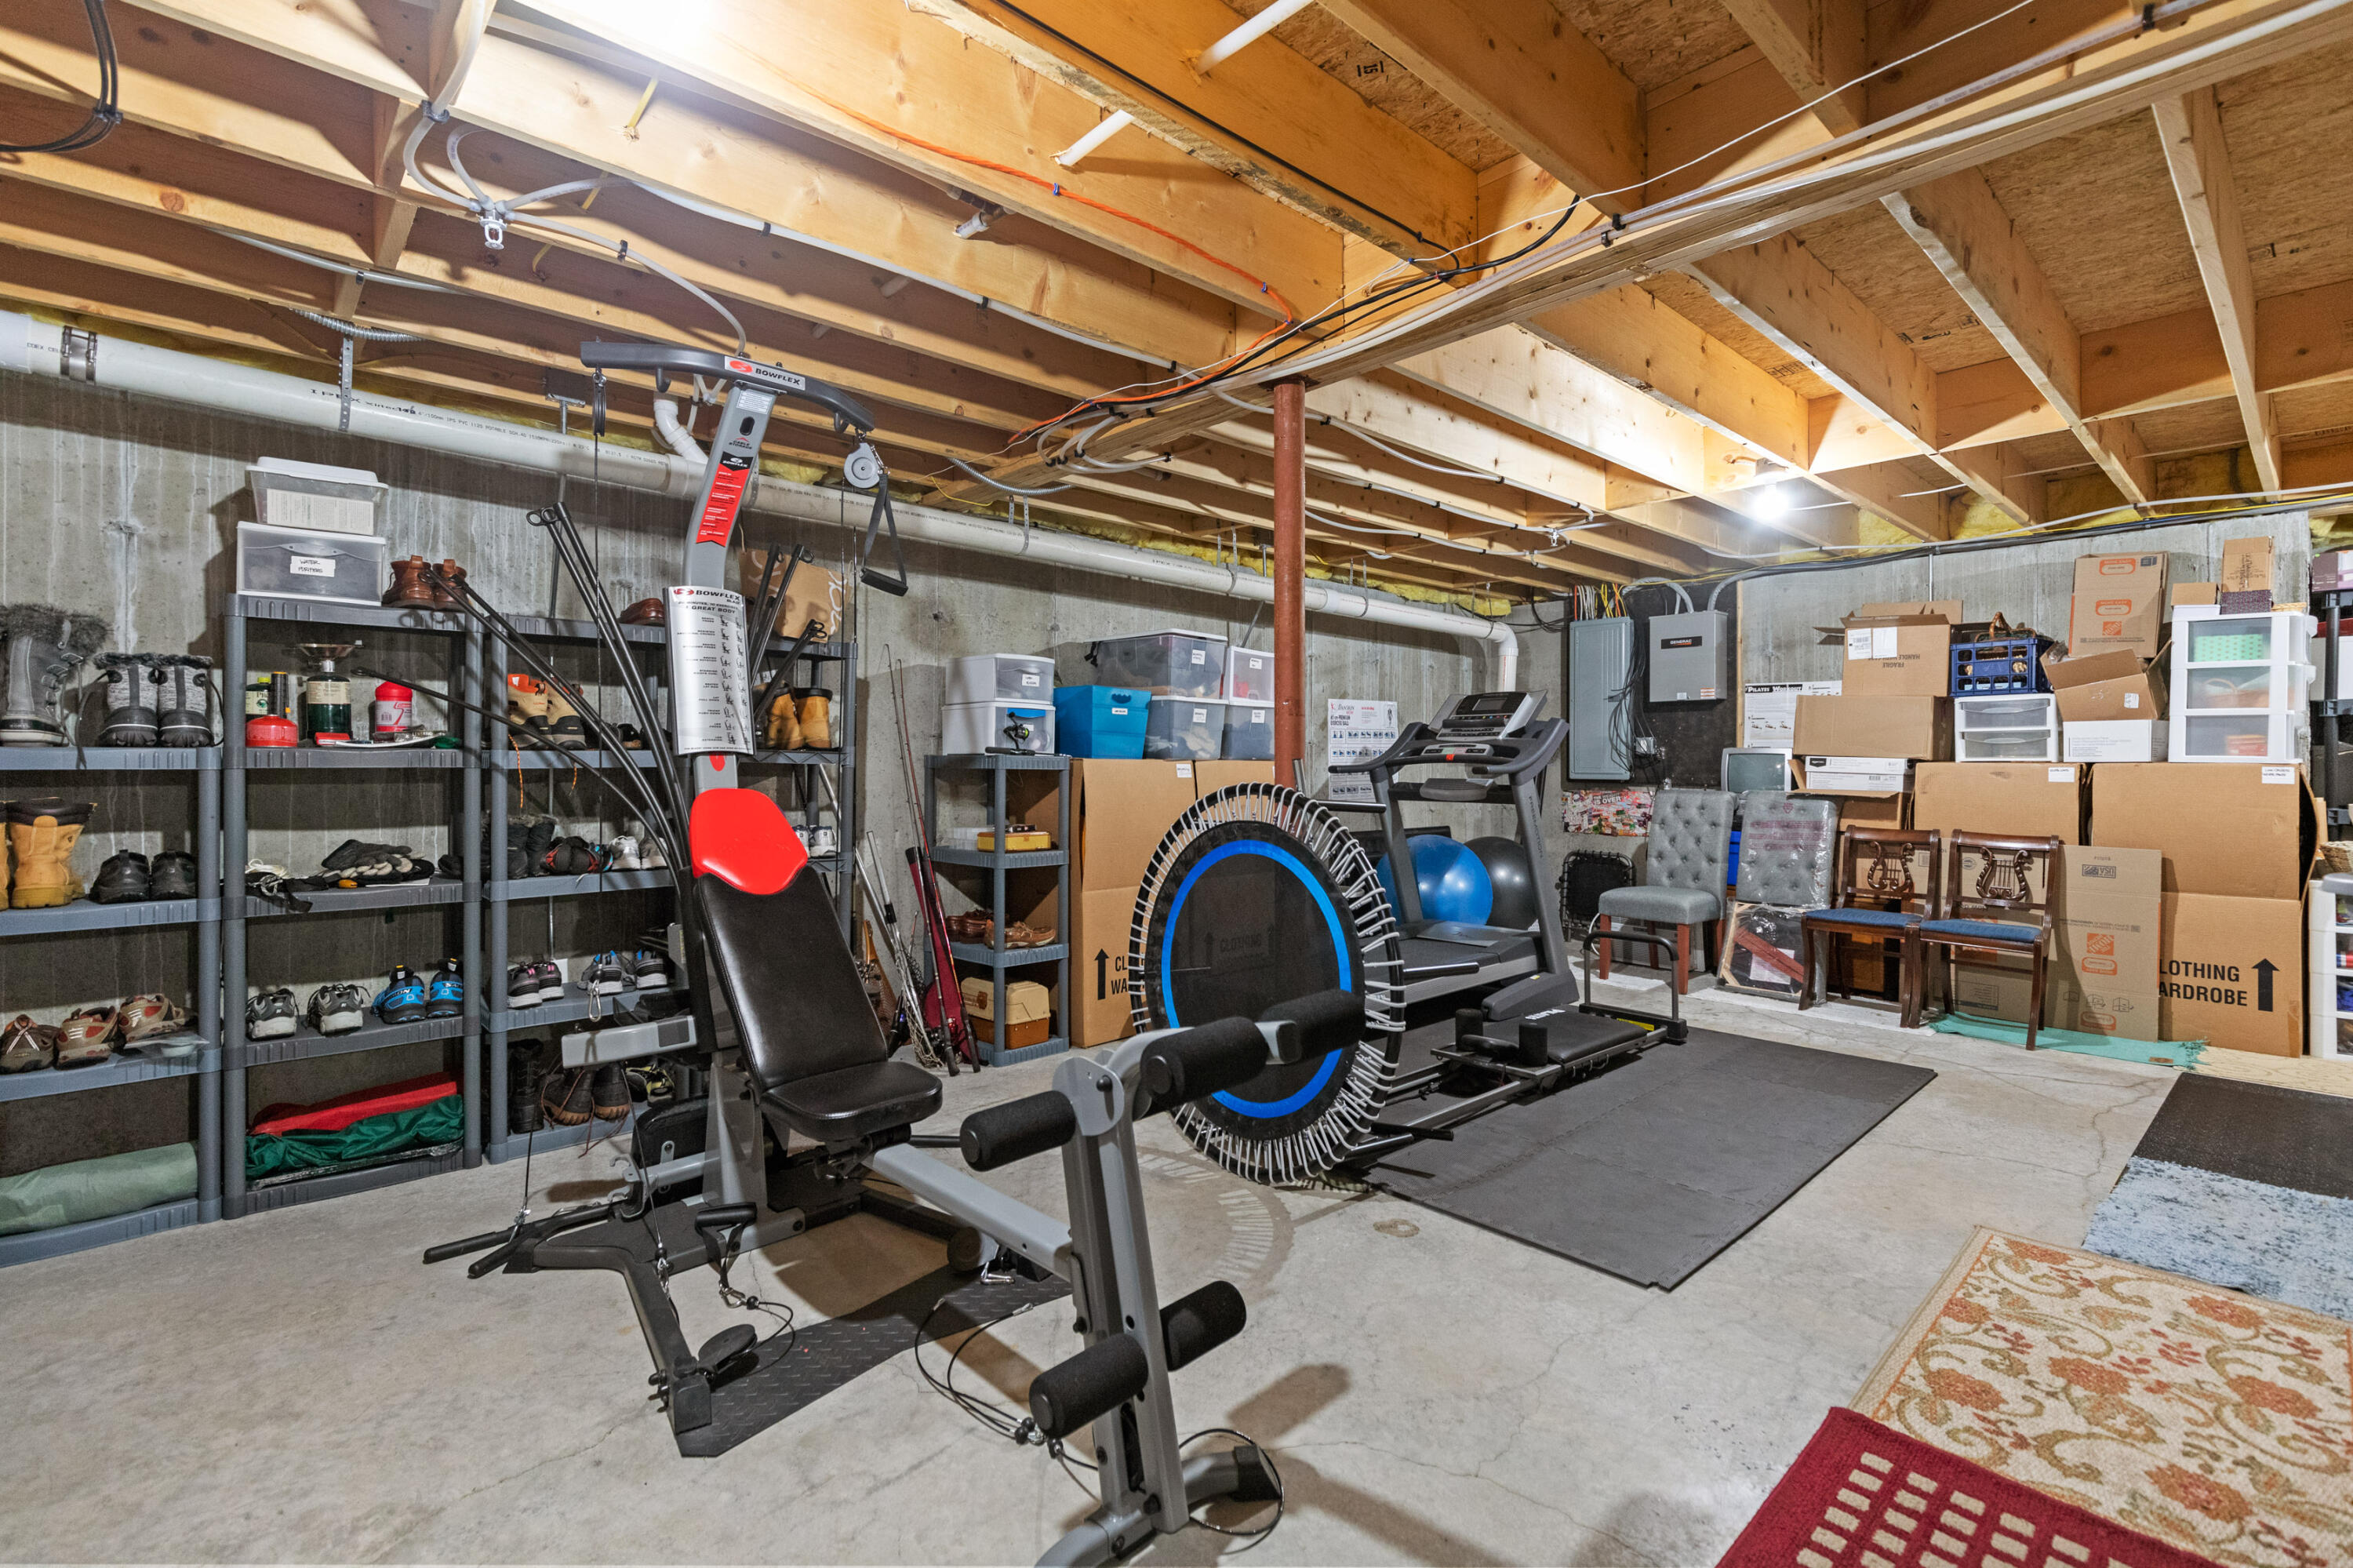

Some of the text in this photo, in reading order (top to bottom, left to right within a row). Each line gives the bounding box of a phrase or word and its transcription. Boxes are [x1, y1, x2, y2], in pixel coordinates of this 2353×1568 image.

[755, 367, 801, 385] BOWFLEX
[696, 589, 740, 601] BOWFLEX
[2159, 959, 2239, 982] LOTHING
[2159, 981, 2248, 1006] ARDROBE
